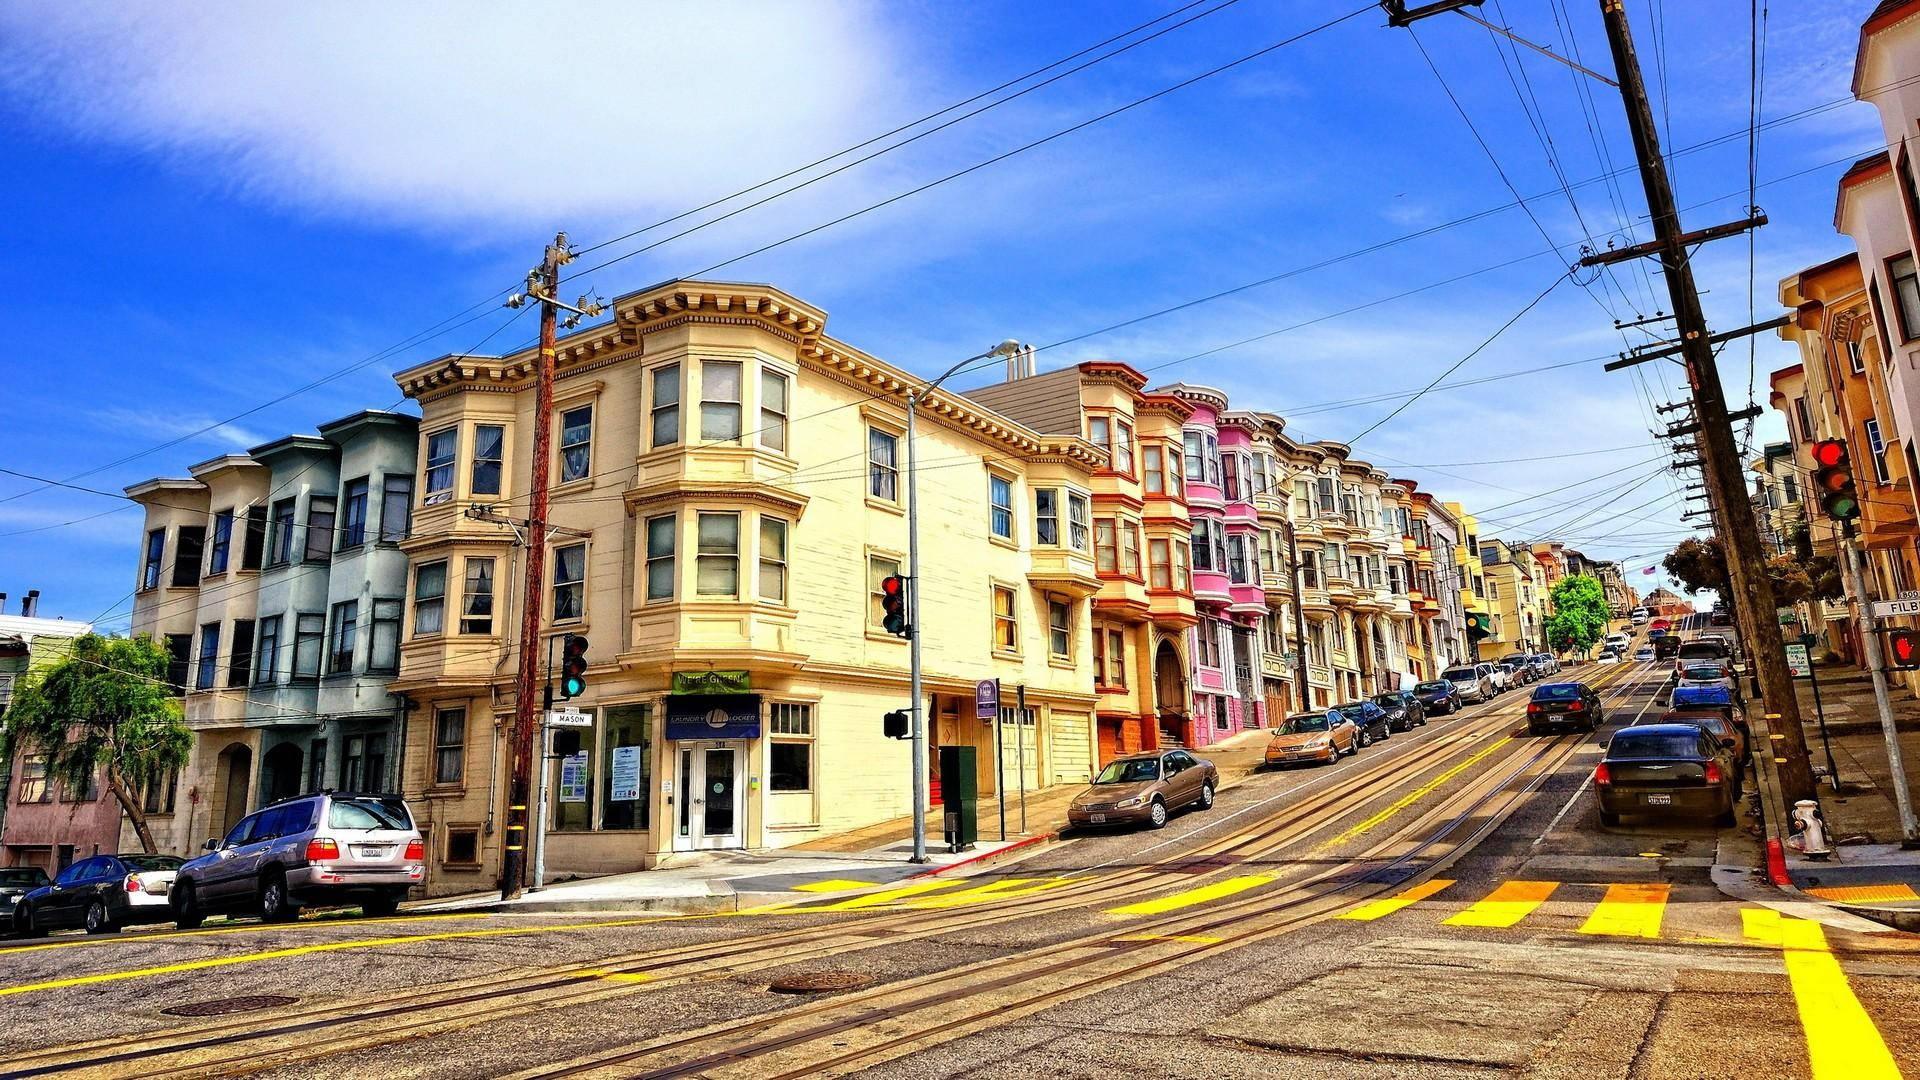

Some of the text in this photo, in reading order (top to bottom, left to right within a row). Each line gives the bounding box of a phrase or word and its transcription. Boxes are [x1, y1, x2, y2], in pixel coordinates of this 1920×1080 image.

[1902, 591, 1918, 600] 800
[678, 675, 707, 685] WE'RE
[559, 715, 585, 723] MASON
[671, 715, 705, 723] LAUNDRY
